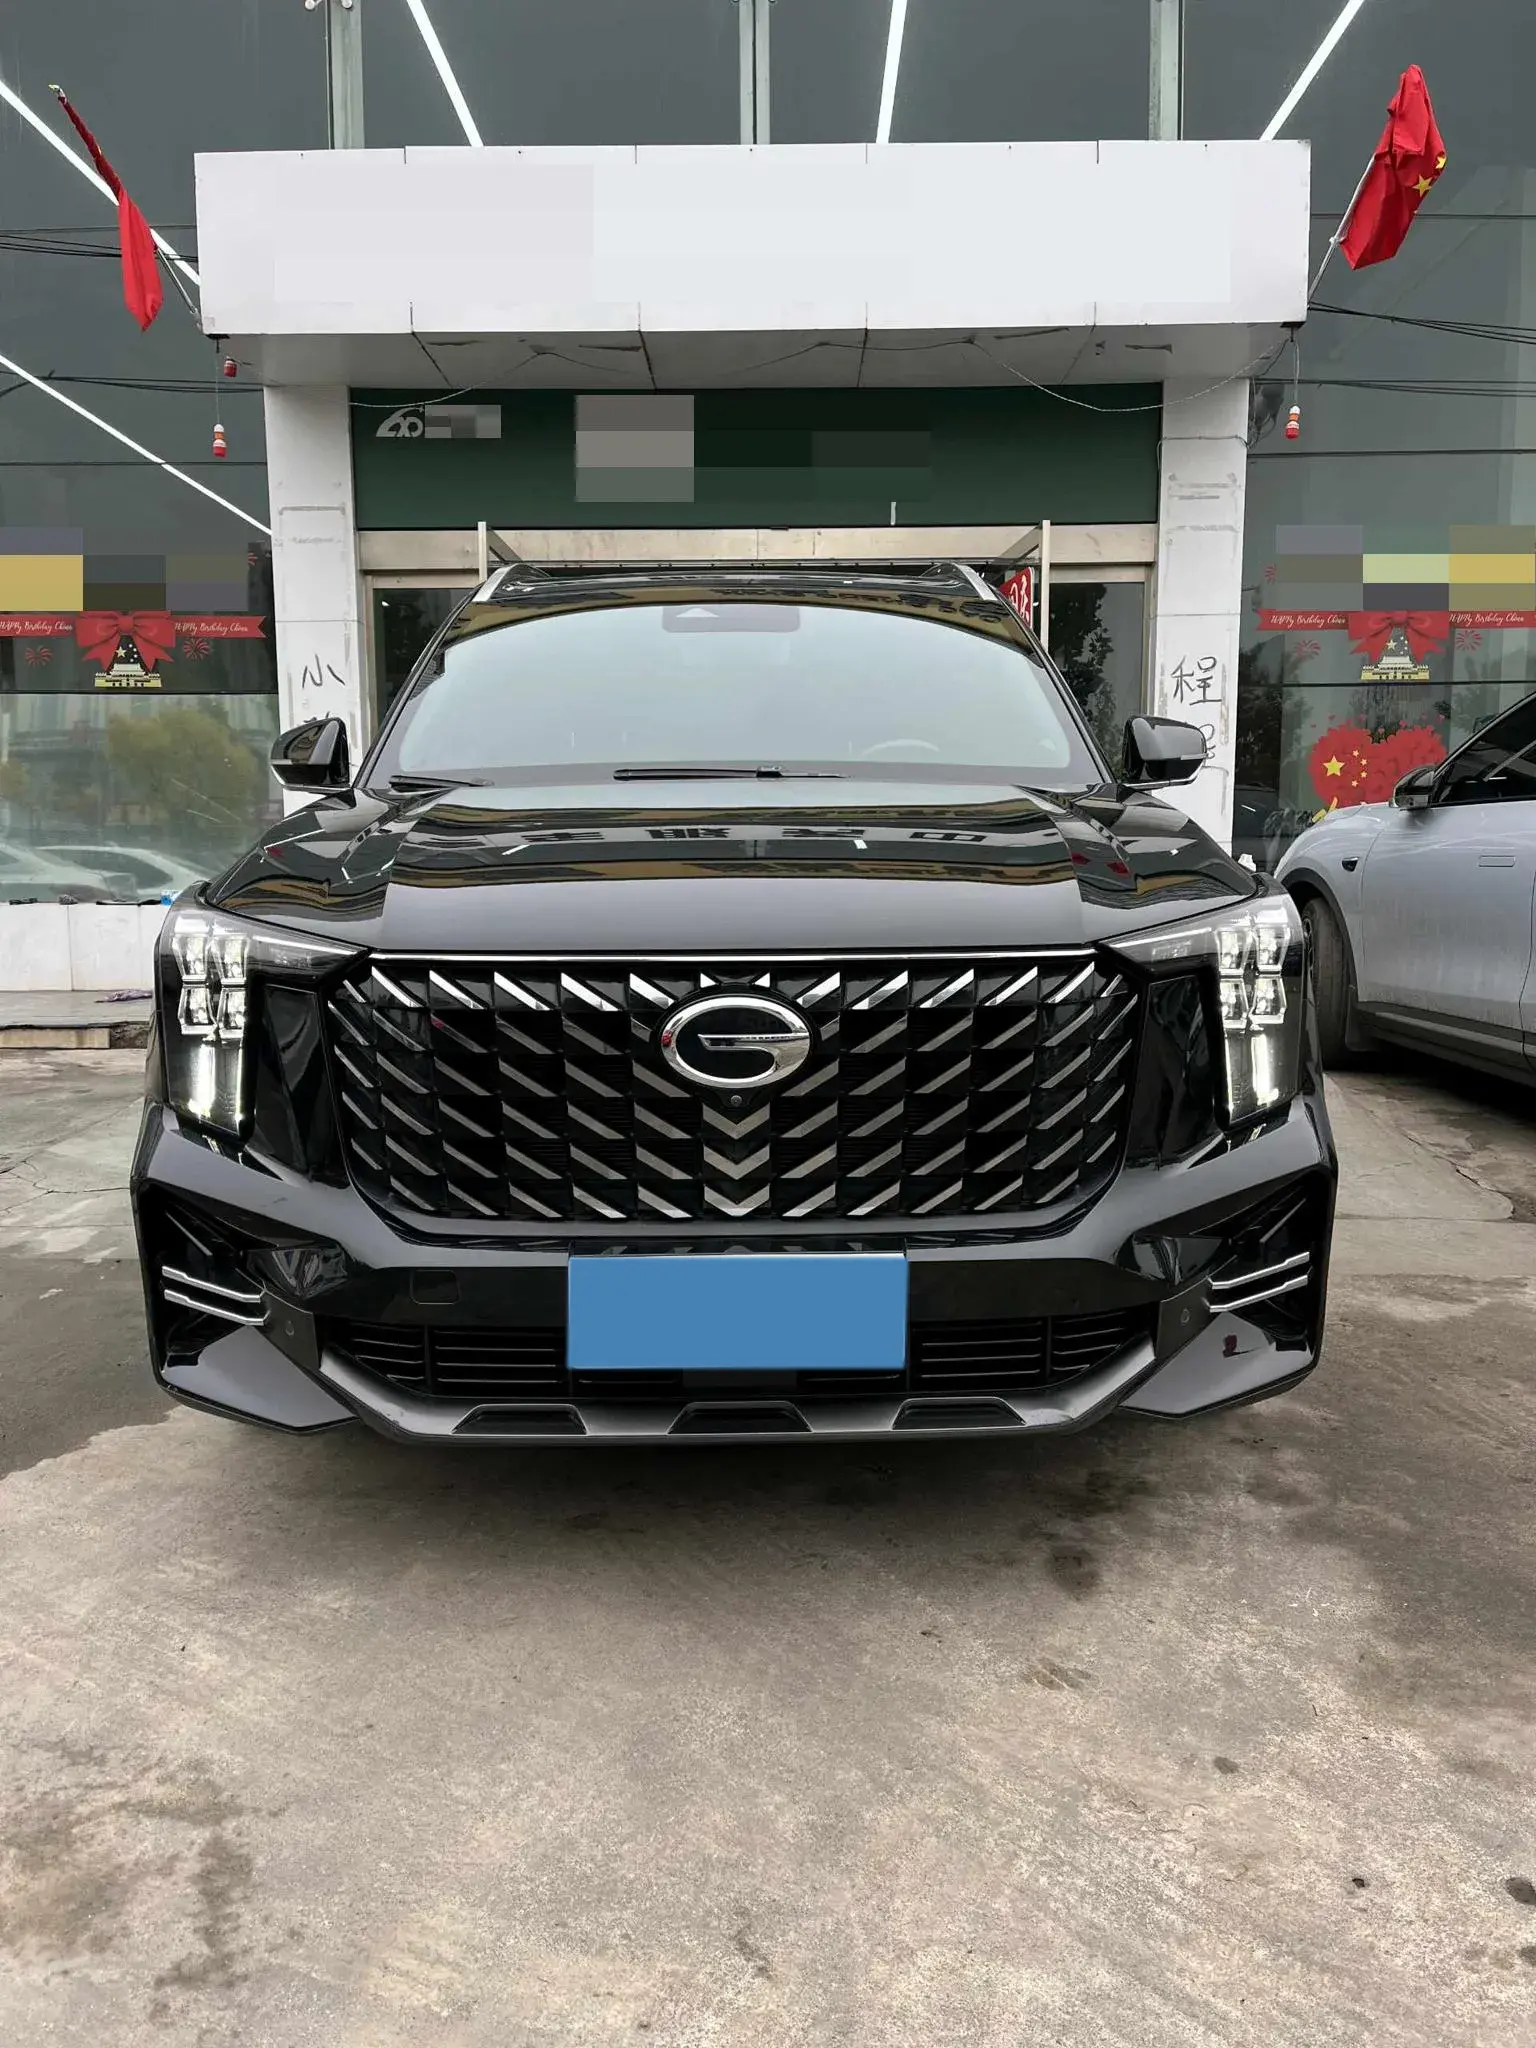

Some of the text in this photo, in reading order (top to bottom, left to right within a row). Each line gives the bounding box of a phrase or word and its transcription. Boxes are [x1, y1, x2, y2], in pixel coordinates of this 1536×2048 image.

[1296, 614, 1325, 629] Birthday
[1475, 612, 1504, 626] Birthday
[24, 621, 53, 635] Birthday
[199, 622, 228, 636] Birthday
